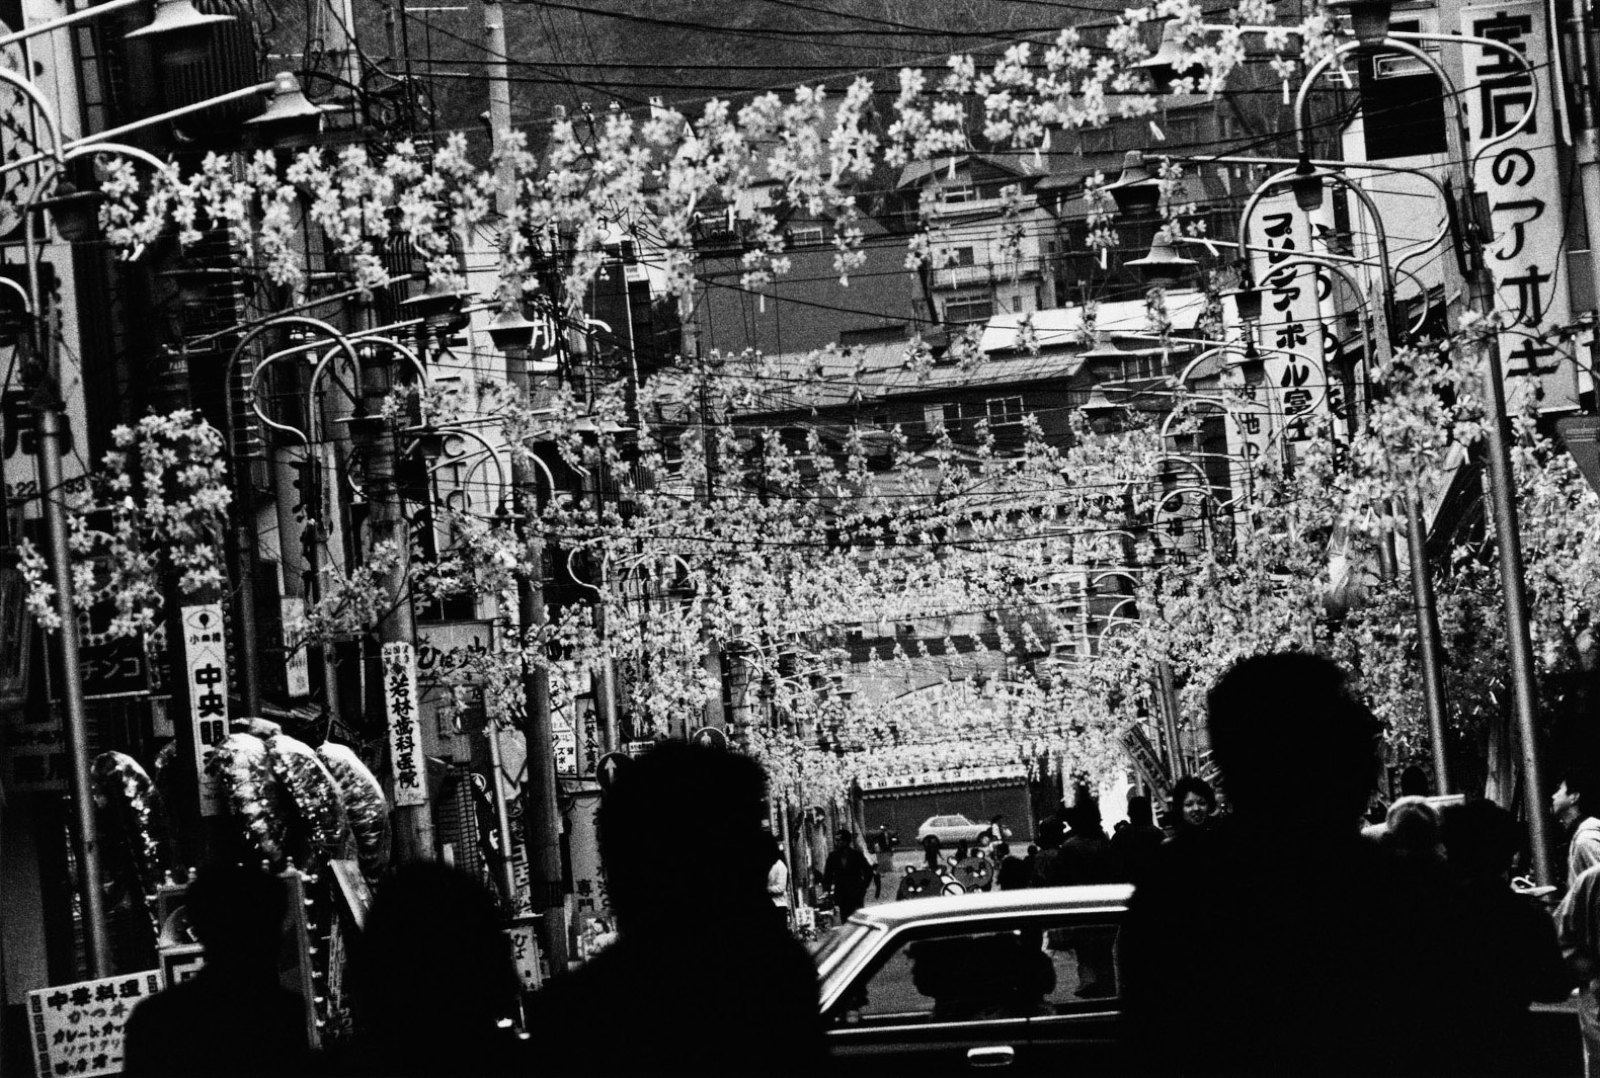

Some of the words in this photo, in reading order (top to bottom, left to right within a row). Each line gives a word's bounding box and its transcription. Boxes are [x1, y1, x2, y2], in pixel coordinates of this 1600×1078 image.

[1473, 11, 1560, 401] 宝石のアオキ
